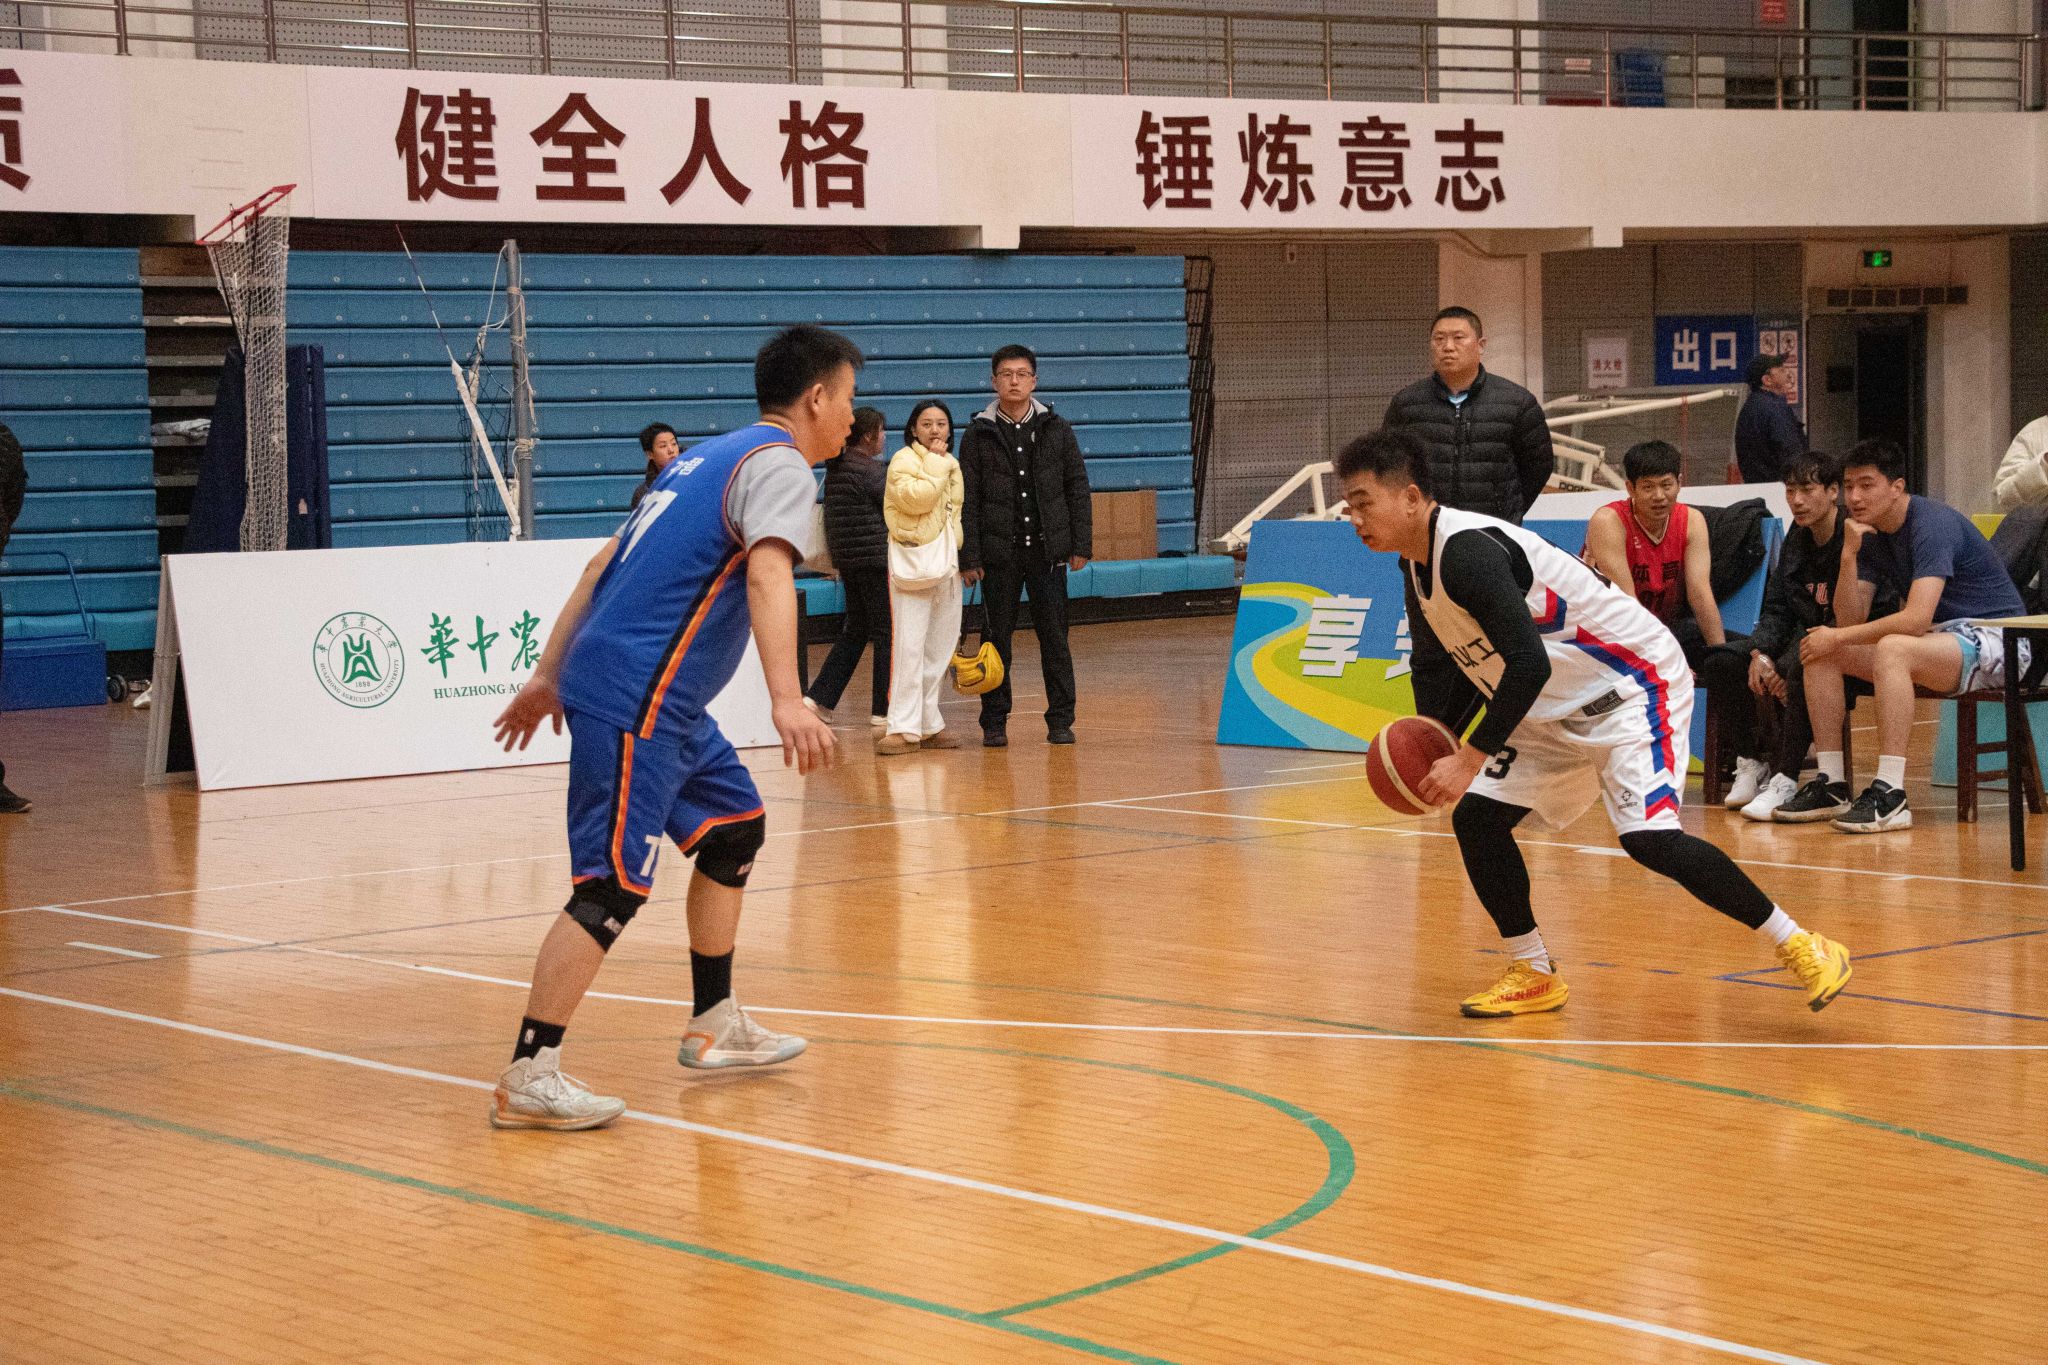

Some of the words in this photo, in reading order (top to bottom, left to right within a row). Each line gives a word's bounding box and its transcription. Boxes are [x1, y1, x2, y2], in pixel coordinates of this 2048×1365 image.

[395, 86, 869, 208] 健全人格
[1135, 109, 1507, 213] 锤炼意志
[1672, 328, 1737, 372] 出口
[433, 683, 506, 699] HUAZHONG
